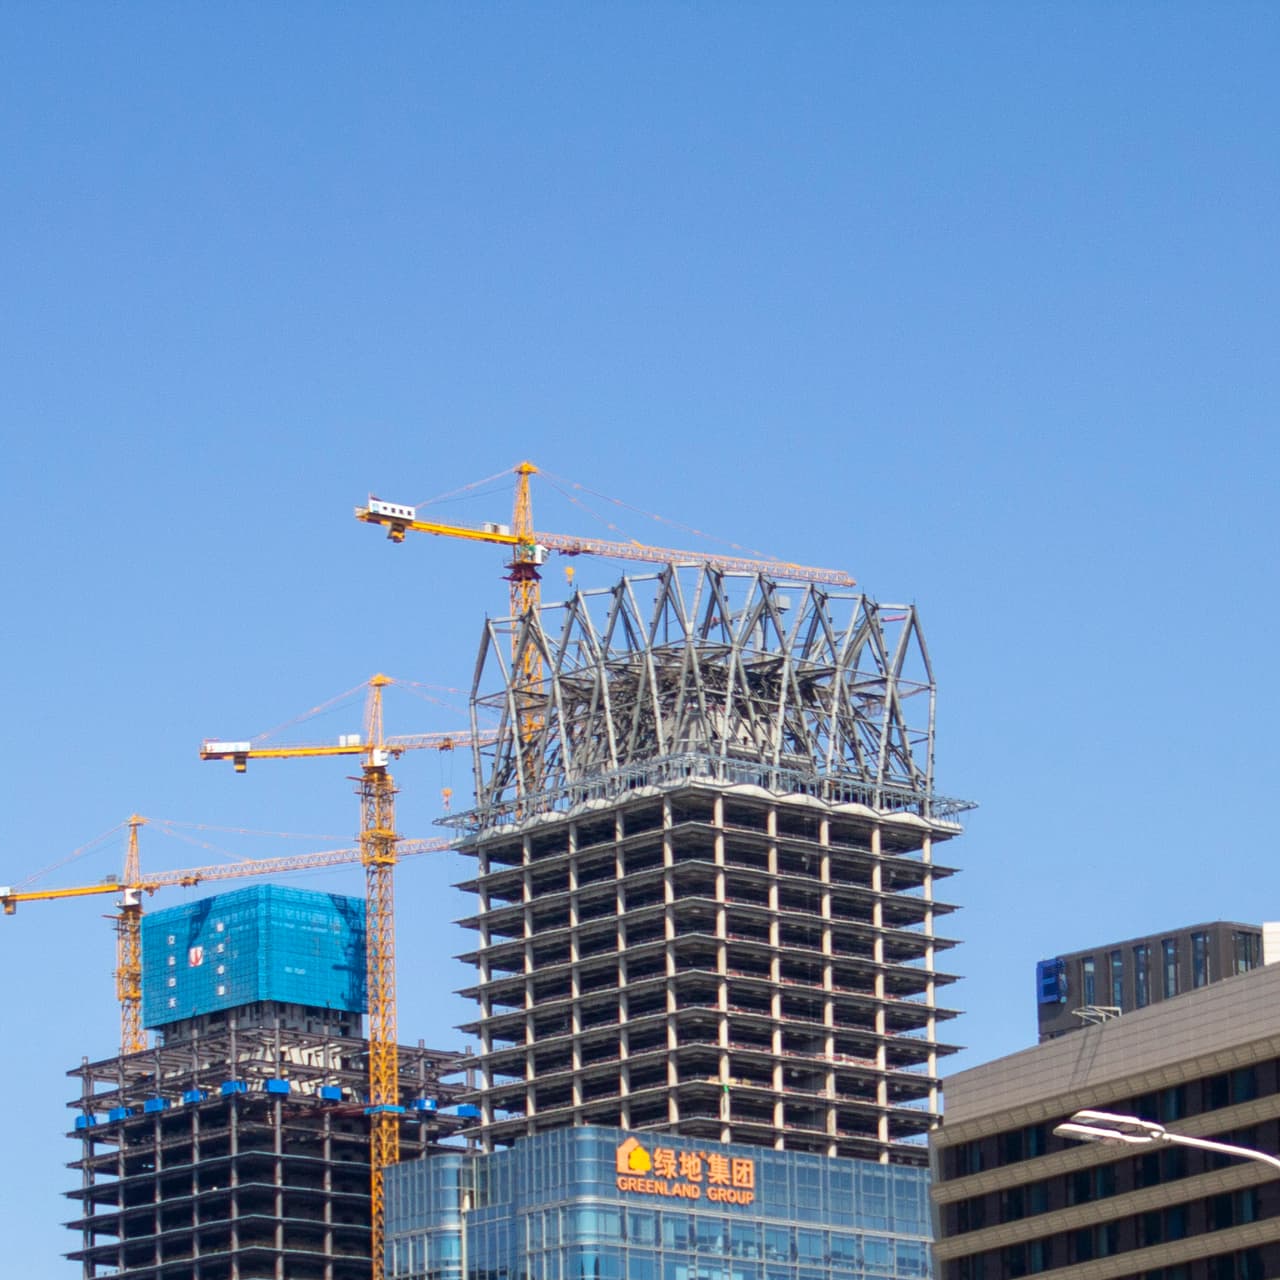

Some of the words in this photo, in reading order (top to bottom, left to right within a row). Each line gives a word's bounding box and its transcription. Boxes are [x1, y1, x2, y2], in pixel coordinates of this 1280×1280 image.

[653, 1147, 755, 1189] 绿地集团
[617, 1176, 701, 1199] GREENLAND
[706, 1186, 755, 1206] GROUP
